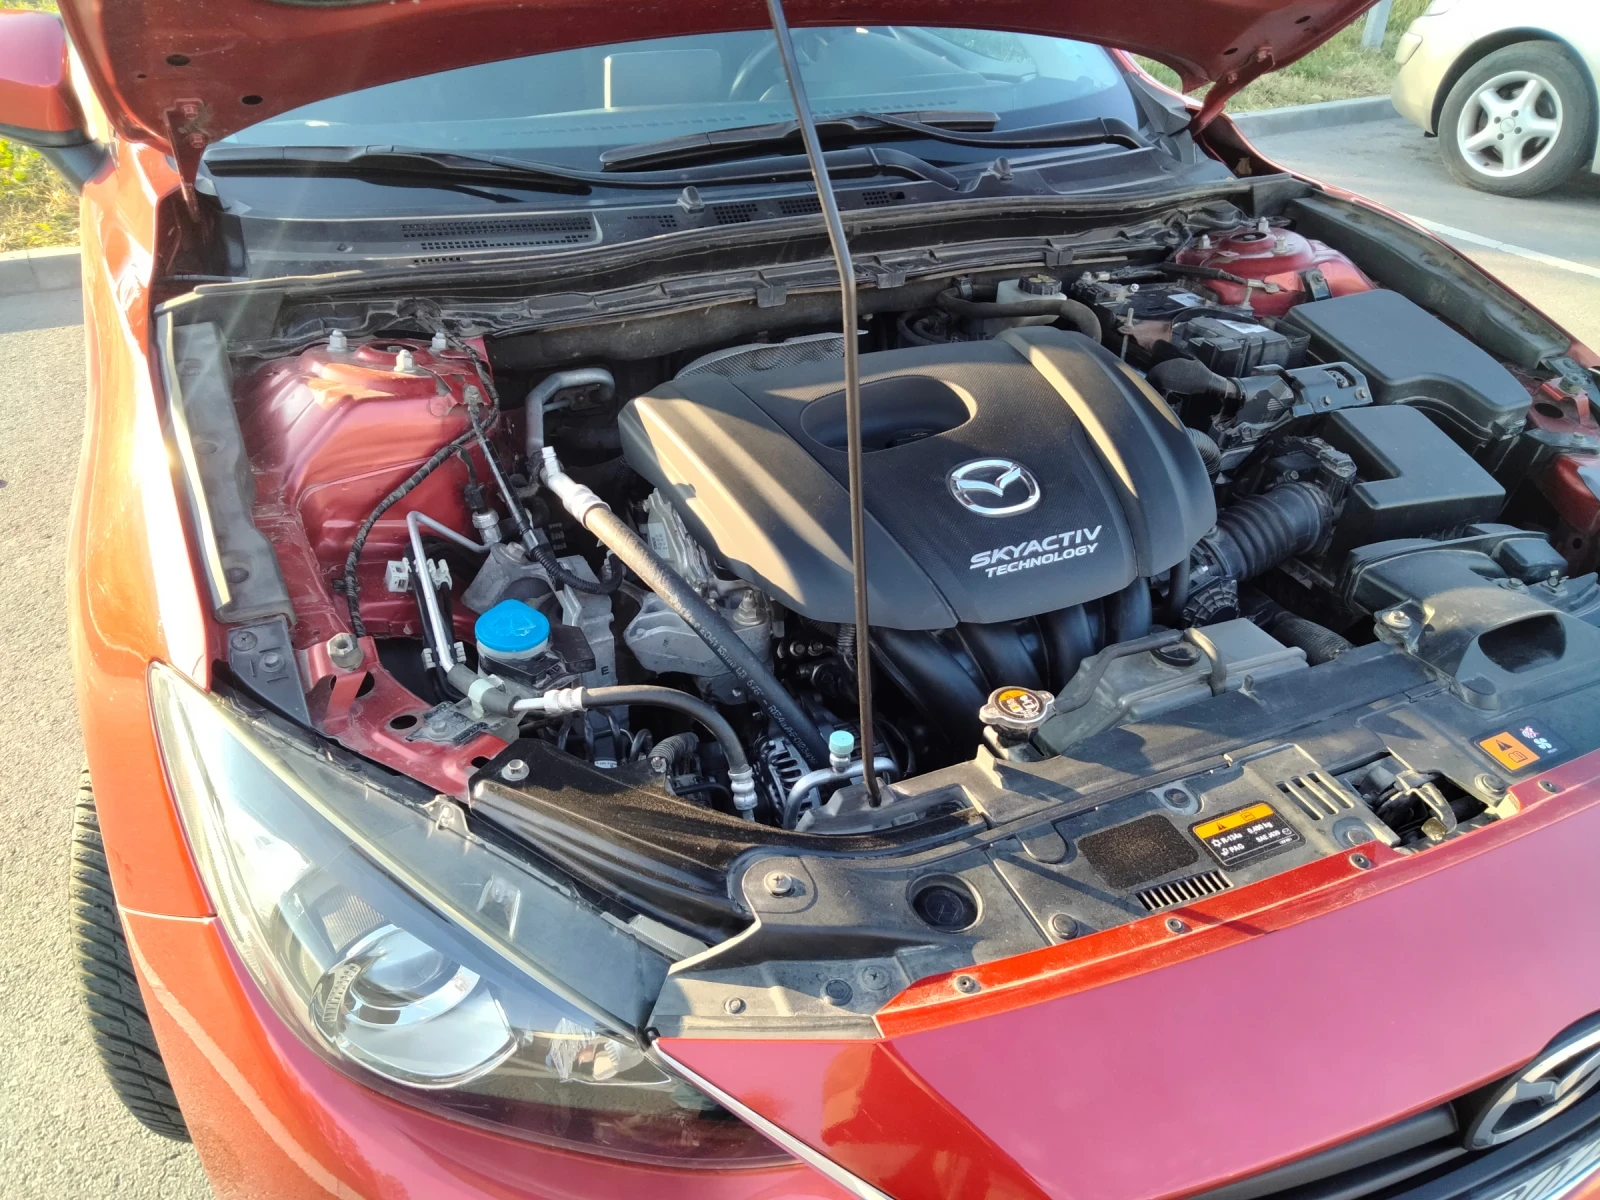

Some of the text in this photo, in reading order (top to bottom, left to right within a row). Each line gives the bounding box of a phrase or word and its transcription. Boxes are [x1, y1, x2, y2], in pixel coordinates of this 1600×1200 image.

[969, 525, 1102, 569] SKYACTIV
[985, 543, 1098, 577] TECHNOLOGY
[601, 665, 609, 675] E
[1220, 833, 1243, 844] R-134a
[1229, 843, 1245, 853] PAG
